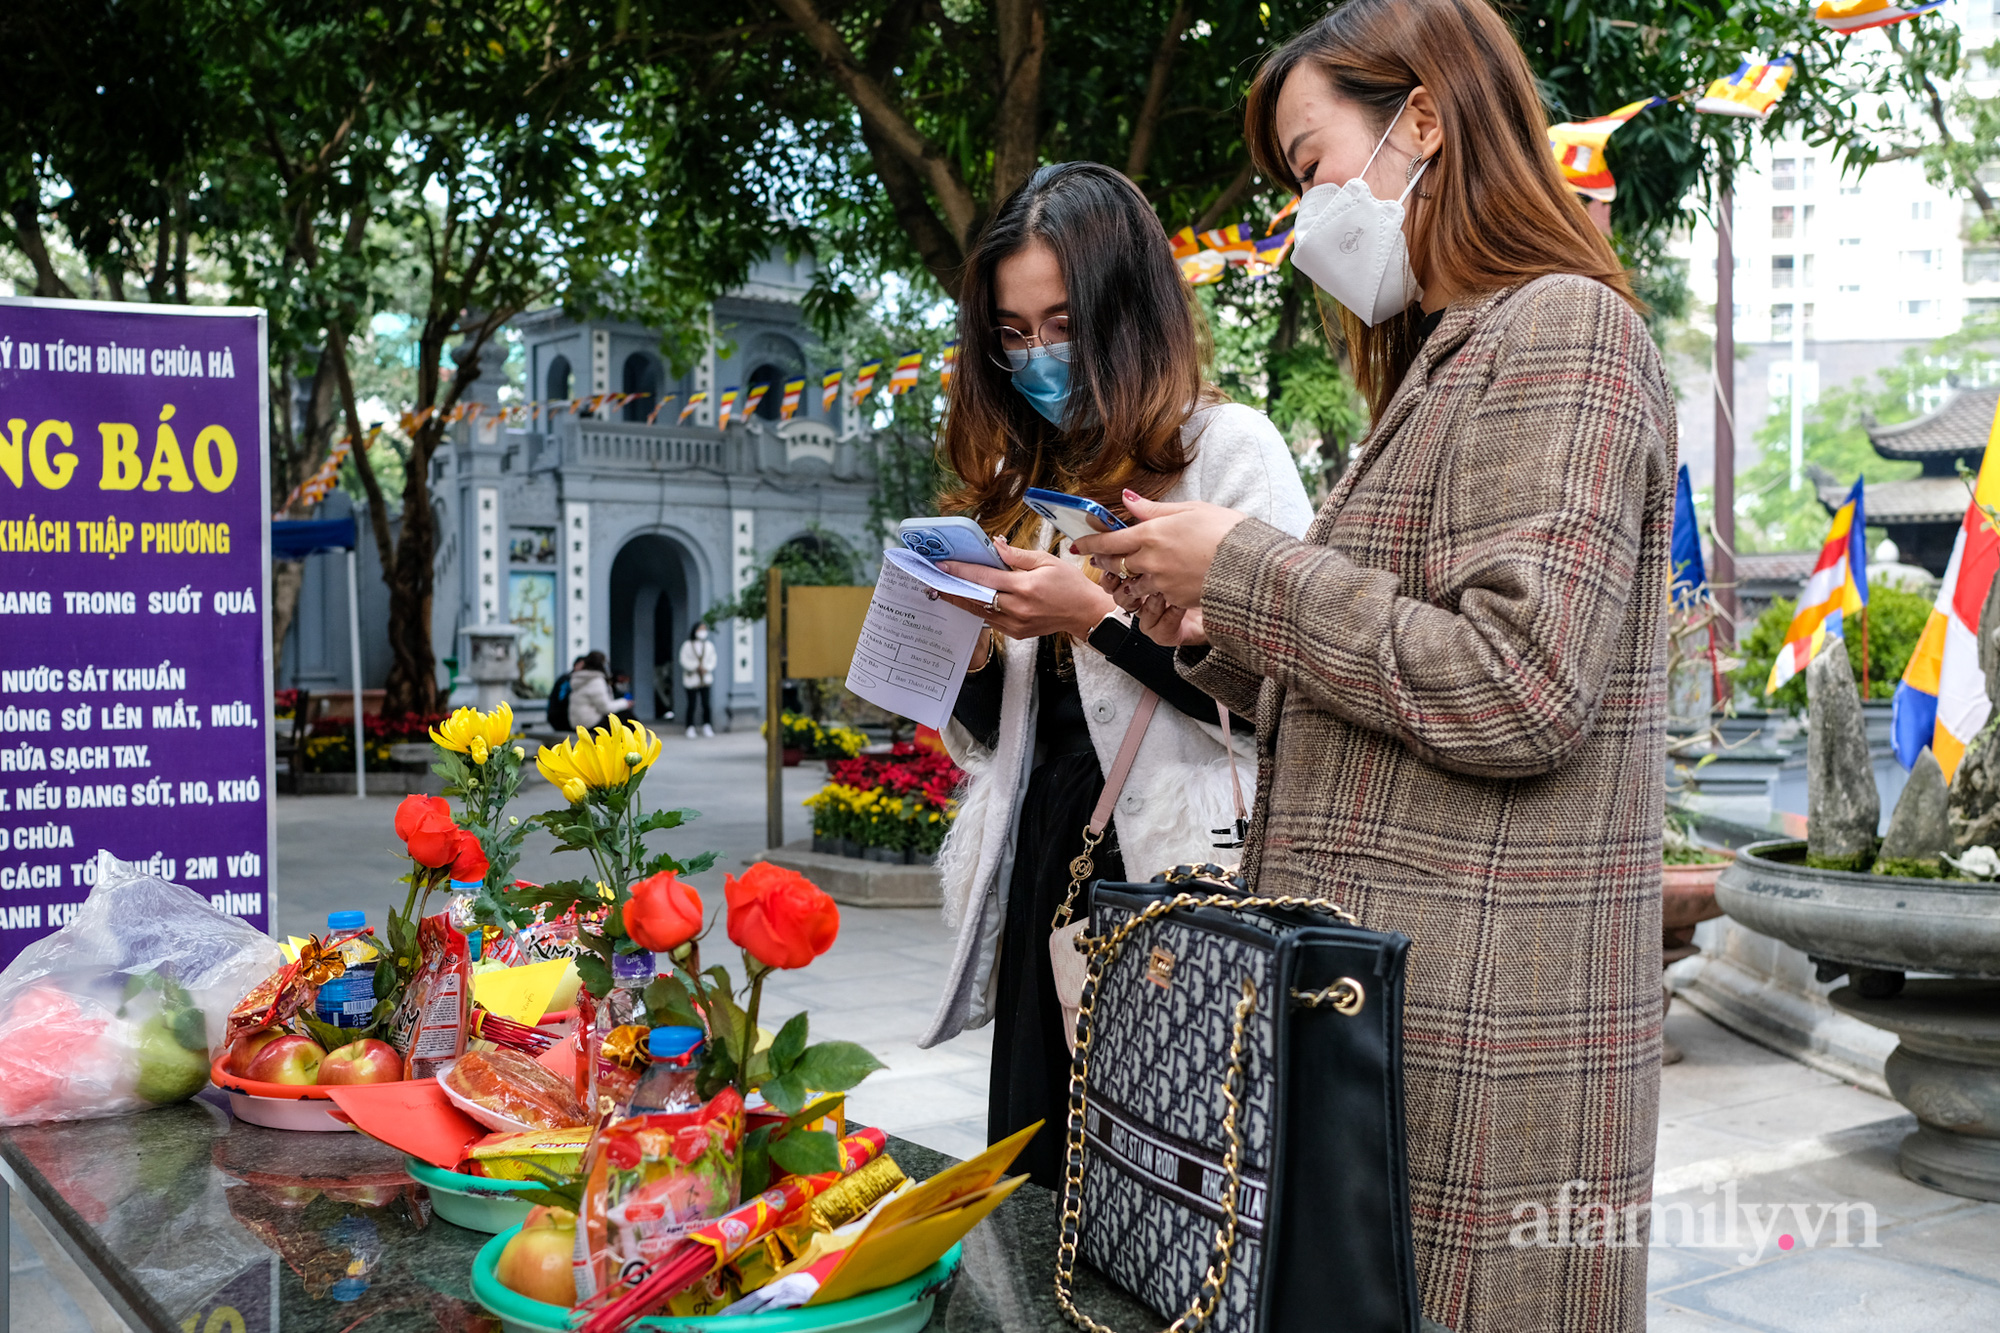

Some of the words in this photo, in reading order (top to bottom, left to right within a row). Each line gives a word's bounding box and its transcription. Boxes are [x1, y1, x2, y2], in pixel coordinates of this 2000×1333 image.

[19, 341, 41, 370] DI
[45, 338, 91, 373] TÍCH
[97, 341, 145, 375] ĐÌNH
[151, 345, 203, 377] CHÙA
[208, 346, 235, 378] HÀ
[98, 403, 238, 493] BÁO
[0, 513, 70, 553] KHÁCH
[77, 515, 134, 560] THẬP
[141, 519, 230, 554] PHƯƠNG
[63, 591, 136, 614] TRONG
[148, 584, 202, 614] SUỐT
[214, 587, 256, 616] QUÁ
[895, 609, 916, 620] DUYÊN
[2, 665, 64, 693] NƯỚC
[67, 665, 108, 692] SÁT
[112, 660, 186, 691] KHUẨN
[0, 704, 51, 732] ÔNG
[61, 703, 92, 730] SỜ
[101, 703, 142, 730] LÊN
[152, 698, 202, 730] MẮT,
[211, 701, 258, 729] MŨI,
[1, 741, 47, 771] RỬA
[50, 746, 109, 774] SẠCH
[113, 745, 151, 769] TAY.
[16, 780, 62, 811] NẾU
[66, 784, 127, 810] ĐANG
[131, 775, 175, 807] SỐT,
[180, 781, 214, 806] HO,
[217, 775, 261, 802] KHÓ
[13, 821, 74, 850] CHÙA
[0, 862, 61, 891] CÁCH
[185, 856, 217, 880] 2M
[227, 853, 261, 877] VỚI
[211, 889, 261, 916] ĐÌNH
[1155, 1148, 1179, 1183] RODI
